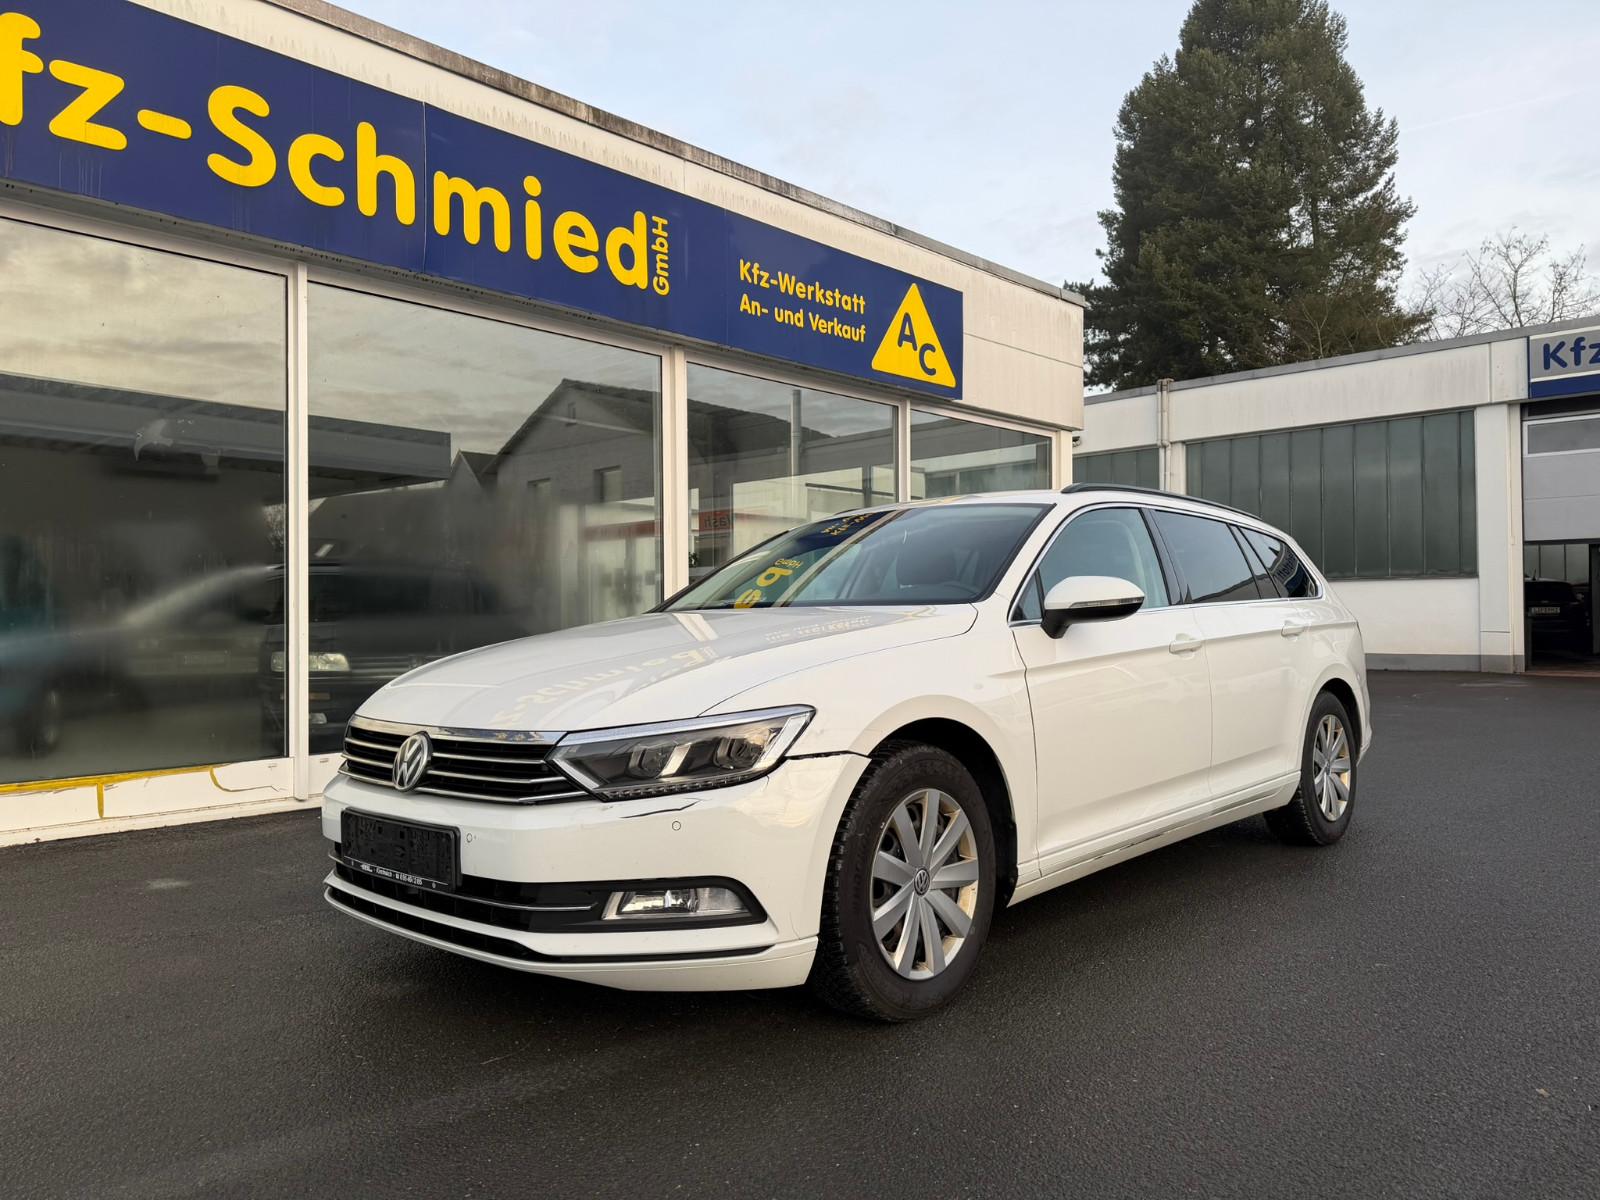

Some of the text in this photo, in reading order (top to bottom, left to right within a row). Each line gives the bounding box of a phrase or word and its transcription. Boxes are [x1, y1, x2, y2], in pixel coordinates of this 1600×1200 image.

[652, 215, 670, 296] GmbH
[739, 259, 866, 315] Kfz-Werkstatt
[739, 293, 866, 343] An- und Verkauf
